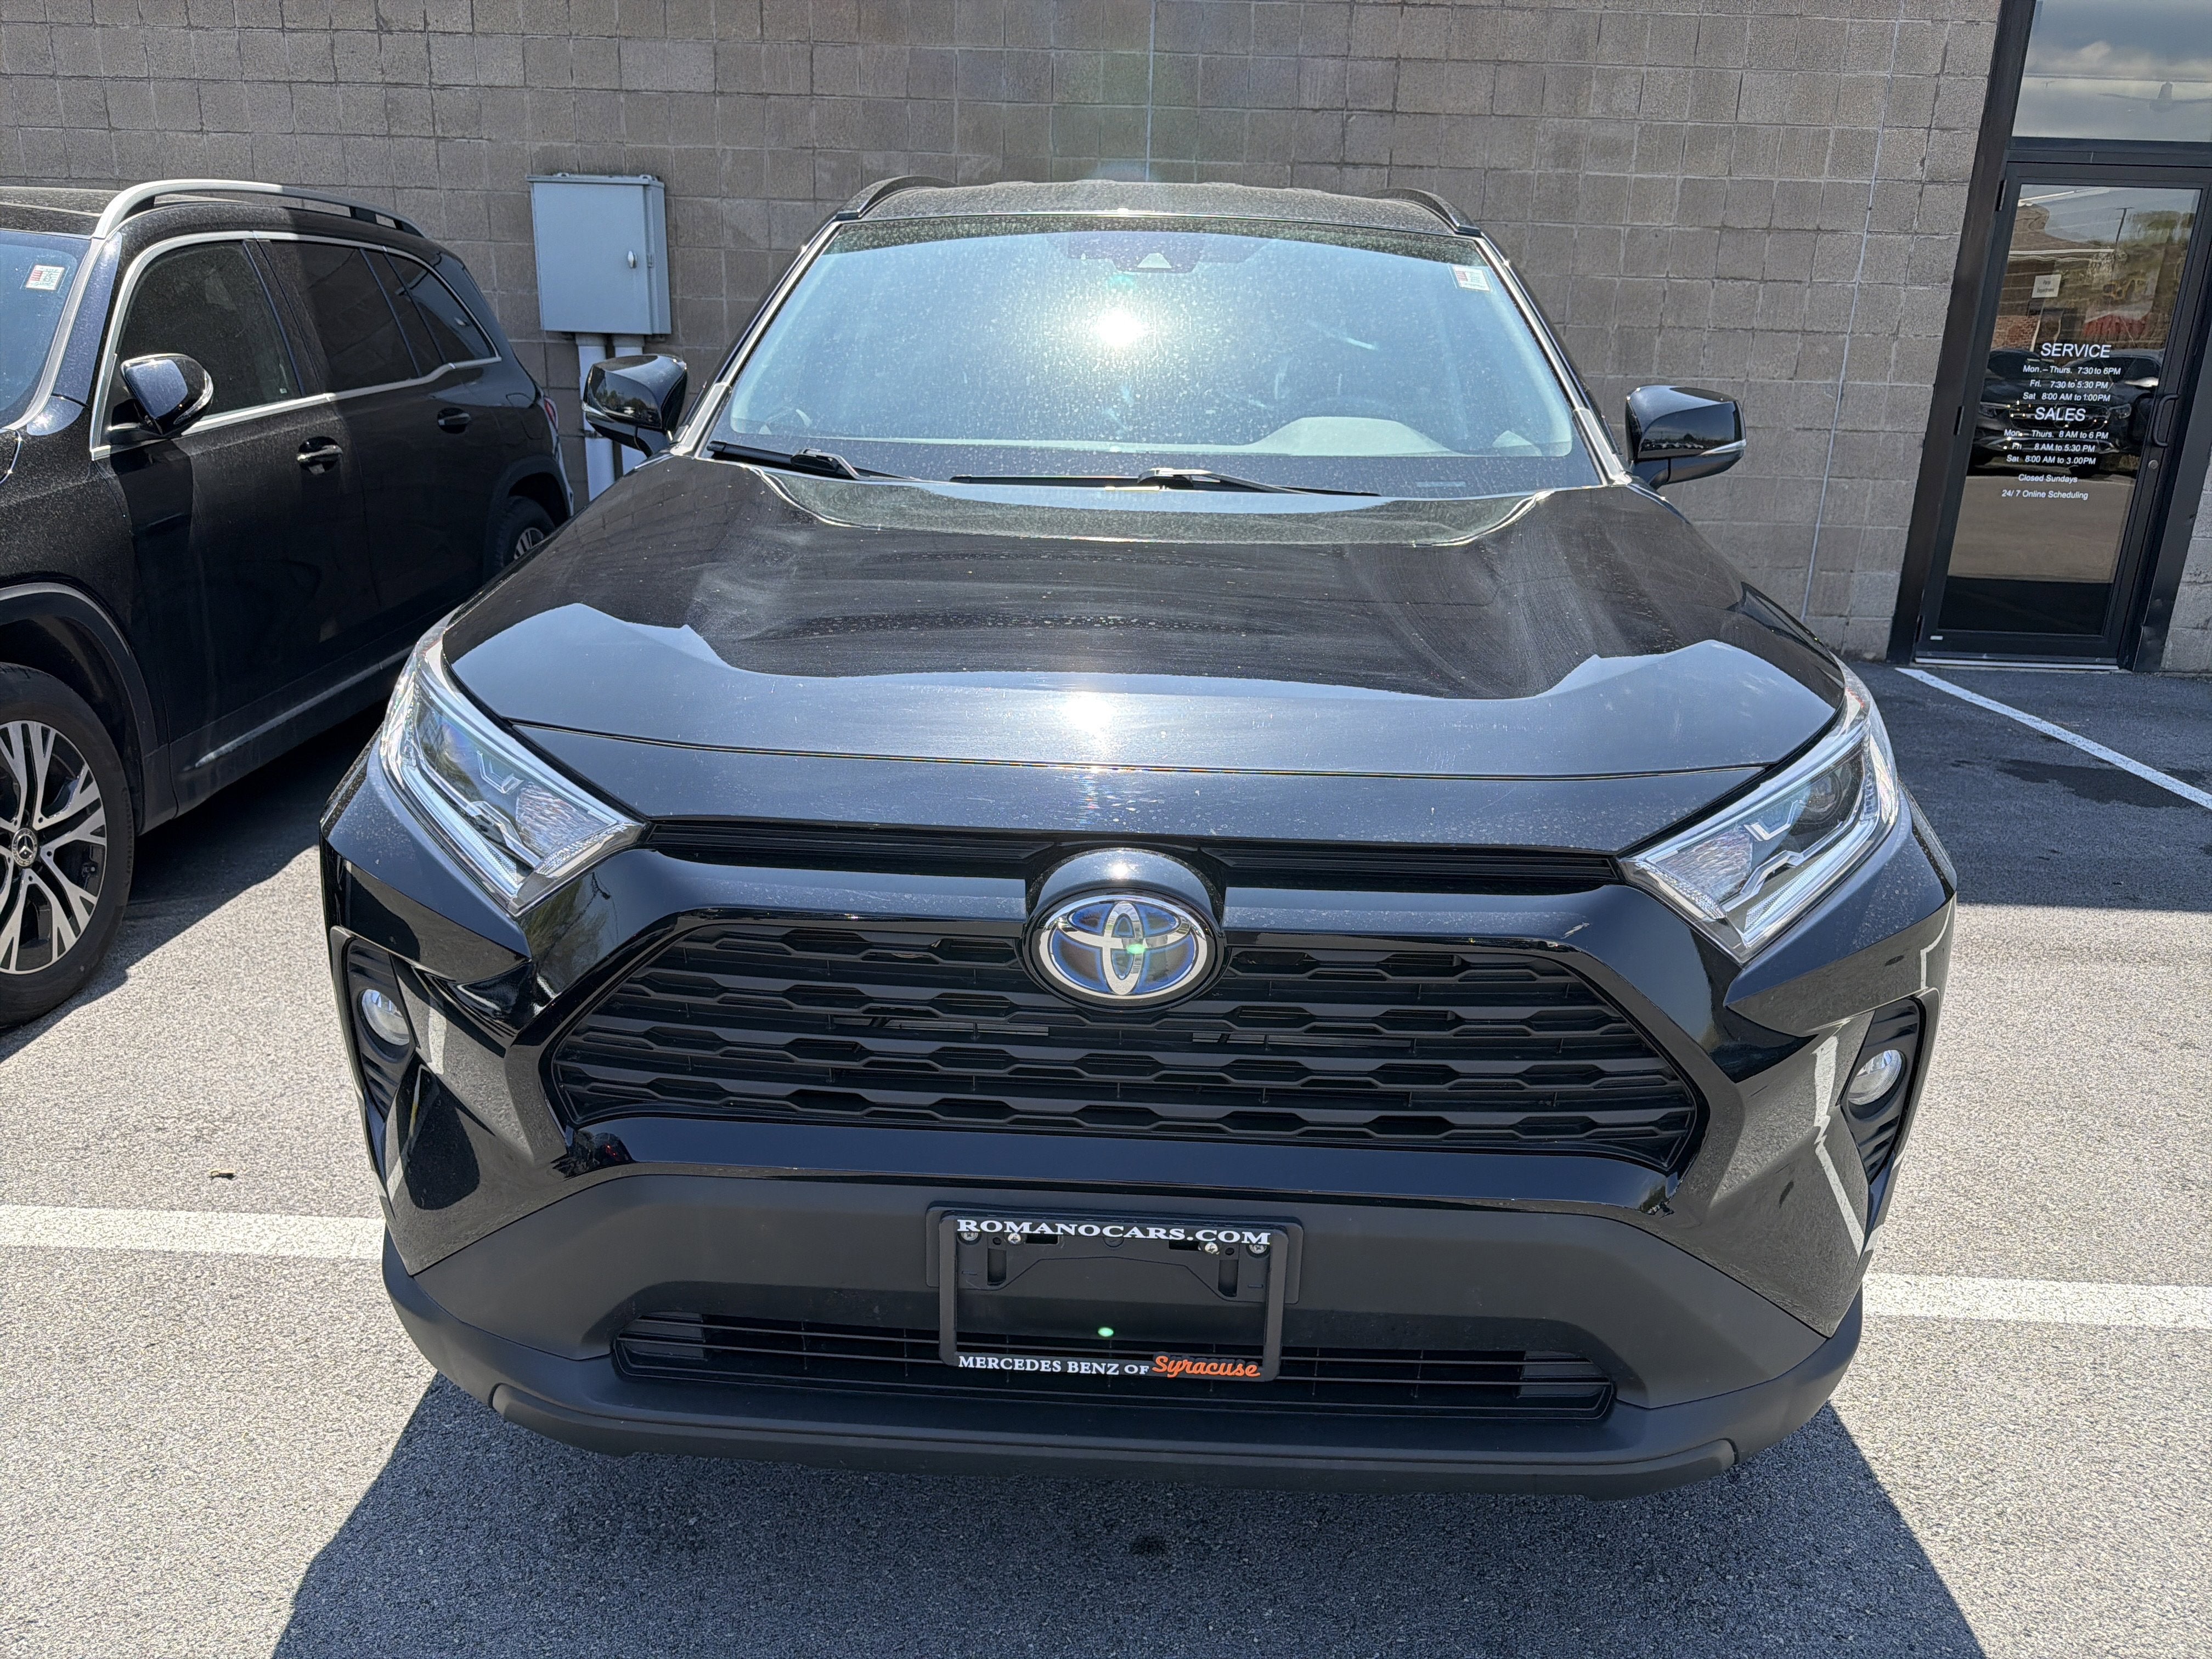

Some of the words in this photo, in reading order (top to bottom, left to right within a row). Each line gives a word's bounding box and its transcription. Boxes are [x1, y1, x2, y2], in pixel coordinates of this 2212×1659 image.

[2041, 343, 2112, 358] SERVICE
[2023, 365, 2042, 373] Mon.
[2049, 365, 2072, 374] Thurs.
[2078, 366, 2094, 375] 7:30
[2103, 367, 2121, 375] 6PM
[2030, 379, 2042, 387] Fri.
[2050, 381, 2067, 389] 7:30
[2076, 381, 2094, 389] 5:30
[2023, 392, 2036, 400] Sat
[2041, 392, 2058, 400] 8:00
[2059, 393, 2073, 401] AM
[2035, 407, 2086, 421] SALES
[2031, 430, 2054, 438] Thurs.
[2055, 443, 2063, 452] to
[2064, 444, 2081, 452] 5:30
[2082, 444, 2096, 453] PM
[2024, 455, 2041, 463] 8:00
[2042, 455, 2056, 464] AM
[2057, 456, 2064, 464] to
[2018, 473, 2044, 482] Closed
[2045, 474, 2078, 484] Sundays
[2022, 489, 2046, 498] Online
[2047, 490, 2089, 500] Scheduling
[957, 1219, 1271, 1244] ROMANOCARS.COM
[958, 1355, 1061, 1373] MERCEDES
[1066, 1360, 1119, 1375] BENZ
[1124, 1364, 1150, 1375] OF
[1152, 1356, 1261, 1378] Syracuse
